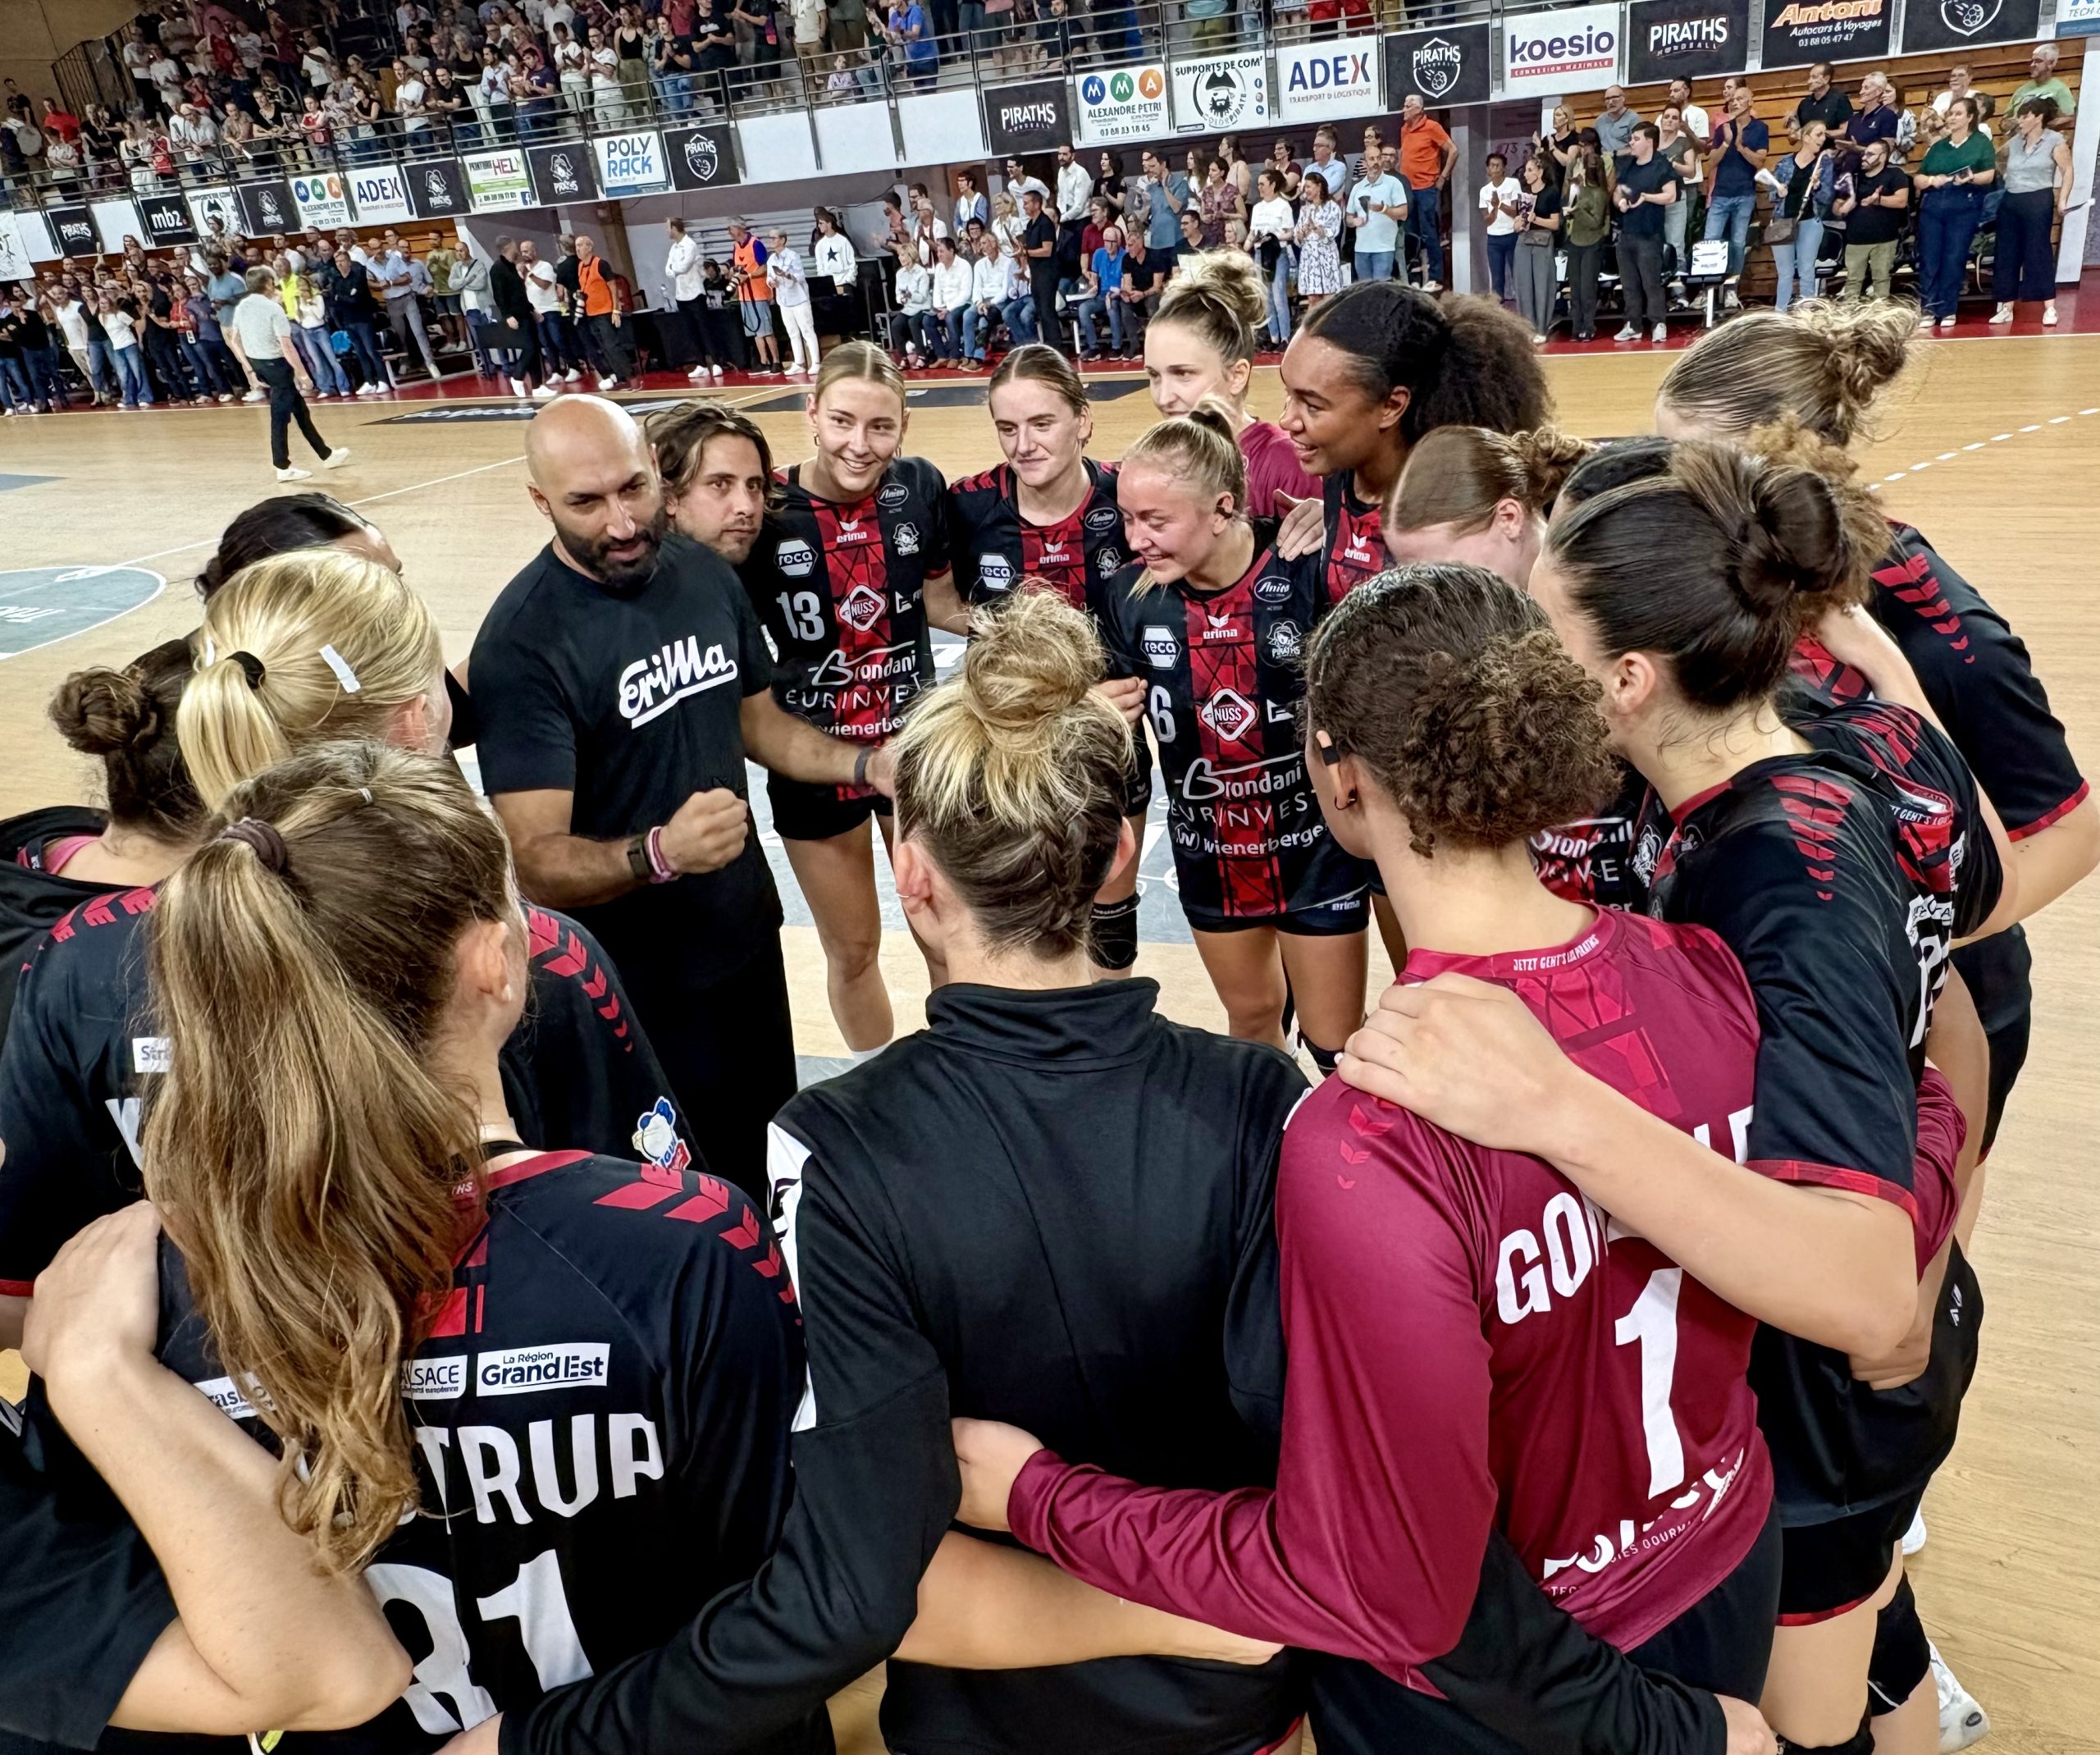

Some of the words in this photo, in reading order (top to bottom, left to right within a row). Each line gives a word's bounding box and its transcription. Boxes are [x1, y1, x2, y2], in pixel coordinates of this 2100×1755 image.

[1650, 17, 1728, 52] PIRATHS
[1789, 25, 1833, 38] Autocars
[1843, 19, 1883, 32] Voyages
[1510, 25, 1614, 63] koesio
[1175, 62, 1221, 76] SUPPORTS
[1223, 60, 1235, 71] DE
[1413, 45, 1461, 68] PIRATHS
[1289, 53, 1371, 92] ADEX
[1001, 103, 1057, 130] PIRATHS
[1088, 104, 1136, 118] ALEXANDRE
[1138, 102, 1162, 113] PETRI
[607, 135, 651, 158] POLY
[608, 156, 652, 178] RACK
[357, 176, 403, 203] ADEX
[836, 532, 868, 543] erima
[1039, 552, 1070, 564] erima
[1344, 547, 1371, 563] erima
[776, 591, 825, 642] 13
[851, 600, 875, 616] NUSS
[1203, 628, 1238, 640] erima
[1144, 641, 1176, 654] reca
[785, 671, 922, 710] EURINVET
[1150, 685, 1176, 743] 6
[1214, 706, 1242, 722] NUSS
[1175, 751, 1305, 801] Brondani
[1171, 790, 1317, 827] EURINVES
[1203, 825, 1328, 855] wienerberge
[1513, 957, 1538, 971] JETZT
[1540, 952, 1567, 970] GEHT'S
[503, 1355, 515, 1364] La
[518, 1351, 554, 1364] Région
[400, 1364, 459, 1386] ALSACE
[1614, 1266, 1685, 1501] 1
[410, 1412, 665, 1535] TRUP
